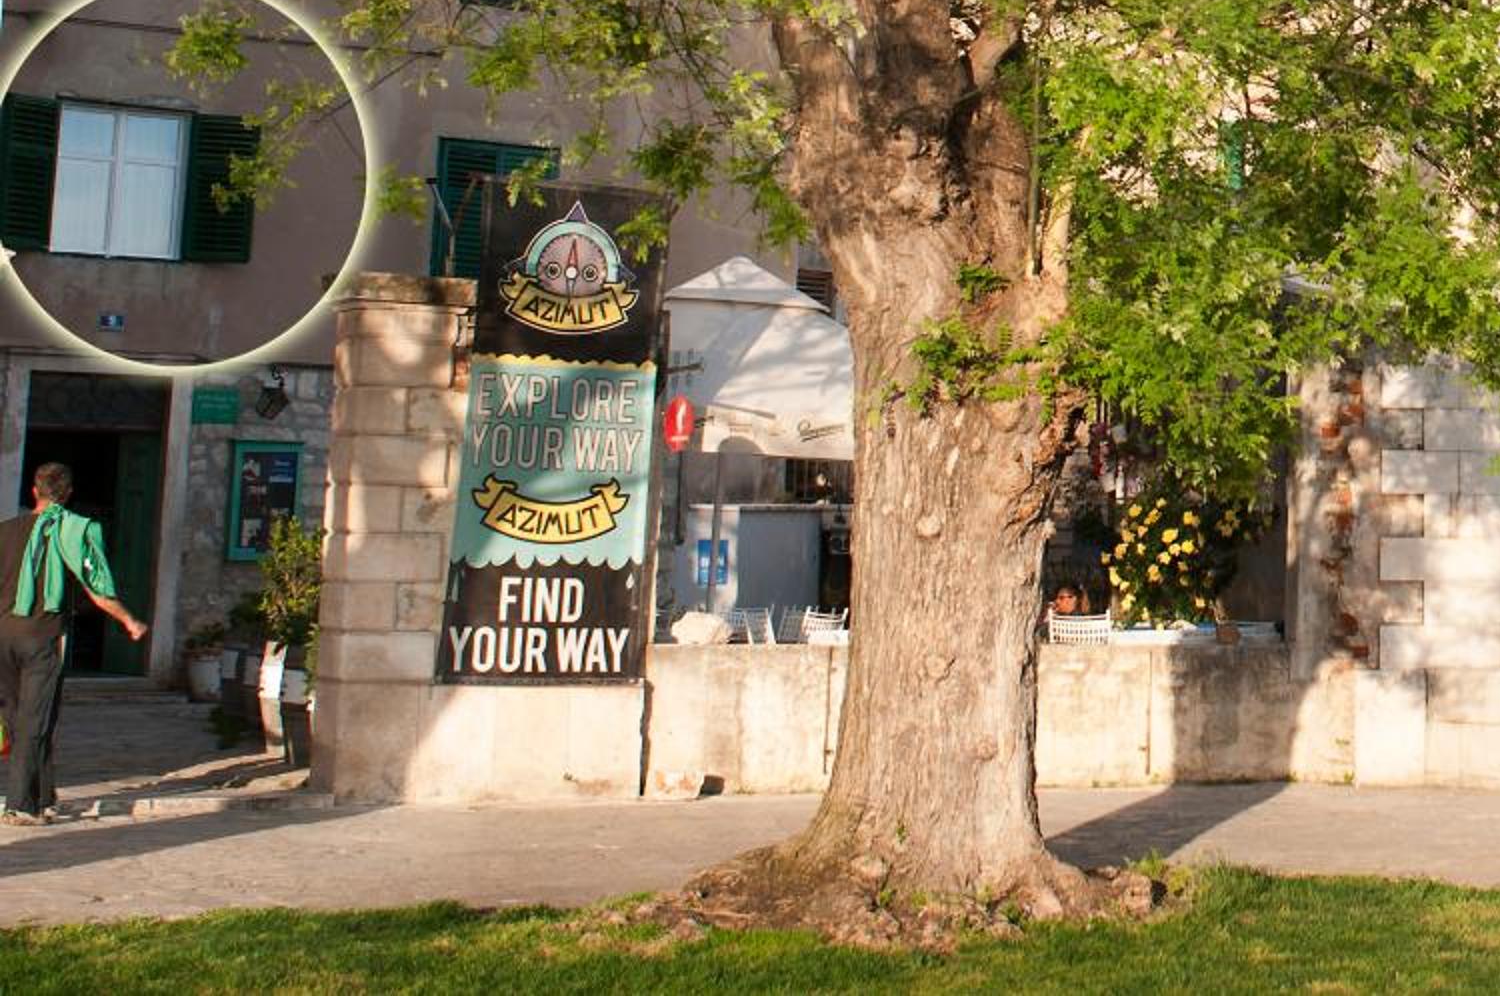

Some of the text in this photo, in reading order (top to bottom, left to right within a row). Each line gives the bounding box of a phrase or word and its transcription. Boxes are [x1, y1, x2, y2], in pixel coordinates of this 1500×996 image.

[522, 295, 610, 324] AZIMUT
[475, 372, 638, 424] EXPLORE
[472, 422, 643, 474] YOUR WAY
[496, 503, 600, 535] AZIMUT
[499, 576, 585, 623] FIND
[449, 625, 630, 673] YOUR WAY
